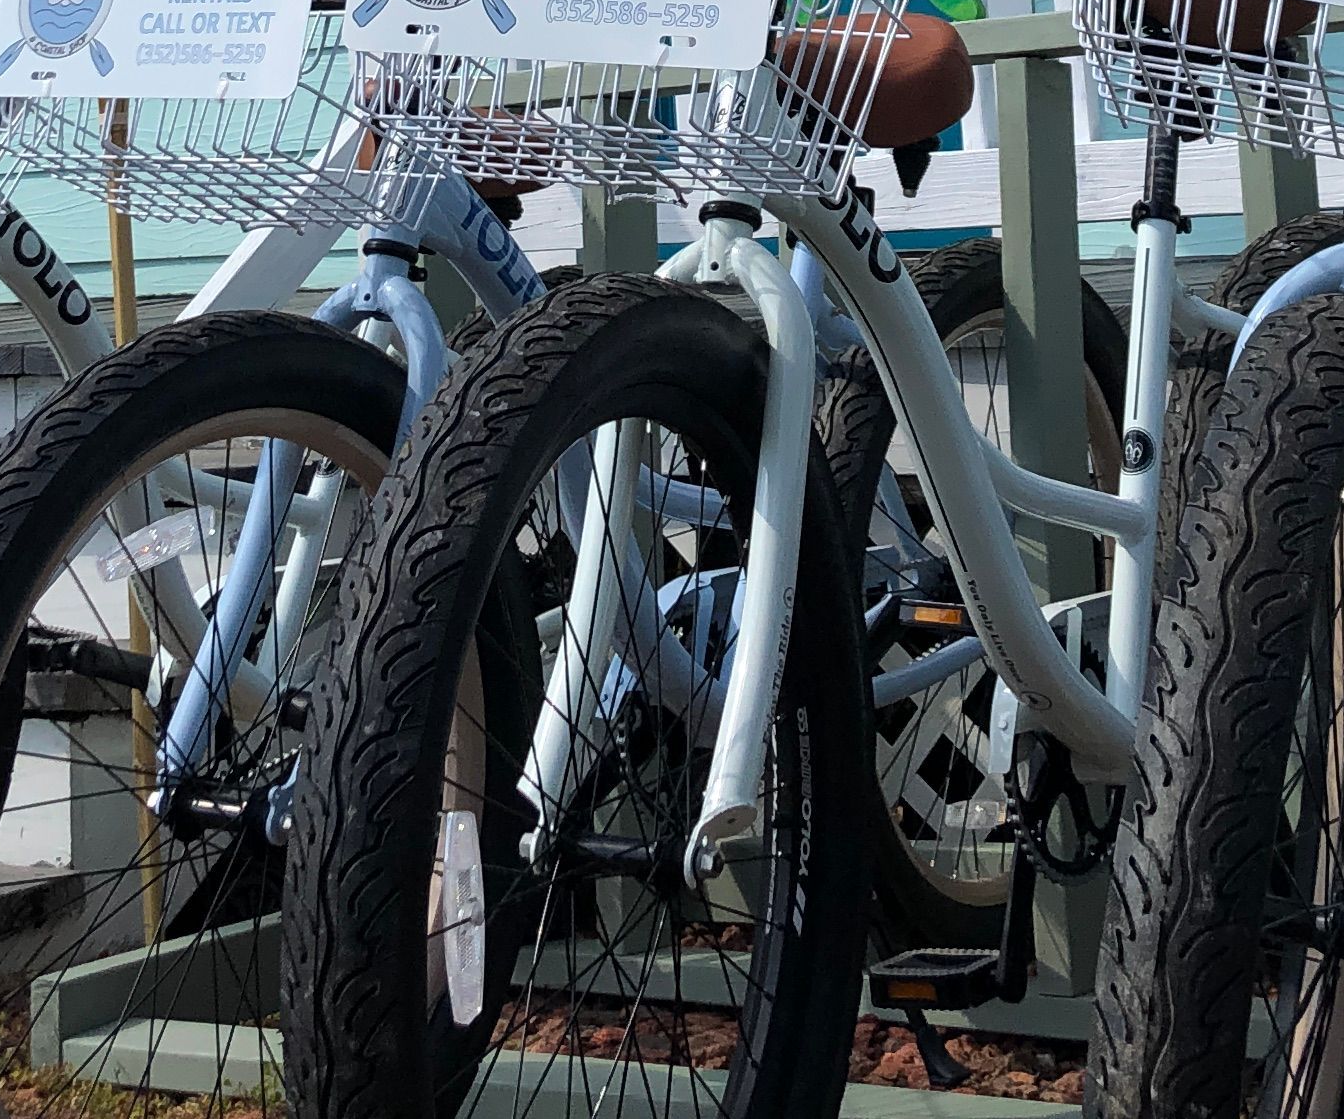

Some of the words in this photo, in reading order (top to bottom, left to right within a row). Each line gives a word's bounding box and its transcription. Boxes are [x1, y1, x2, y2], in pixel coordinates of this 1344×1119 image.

[140, 12, 185, 34] CALL
[190, 11, 220, 33] OR
[225, 10, 275, 33] TEXT
[778, 614, 791, 655] Ride
